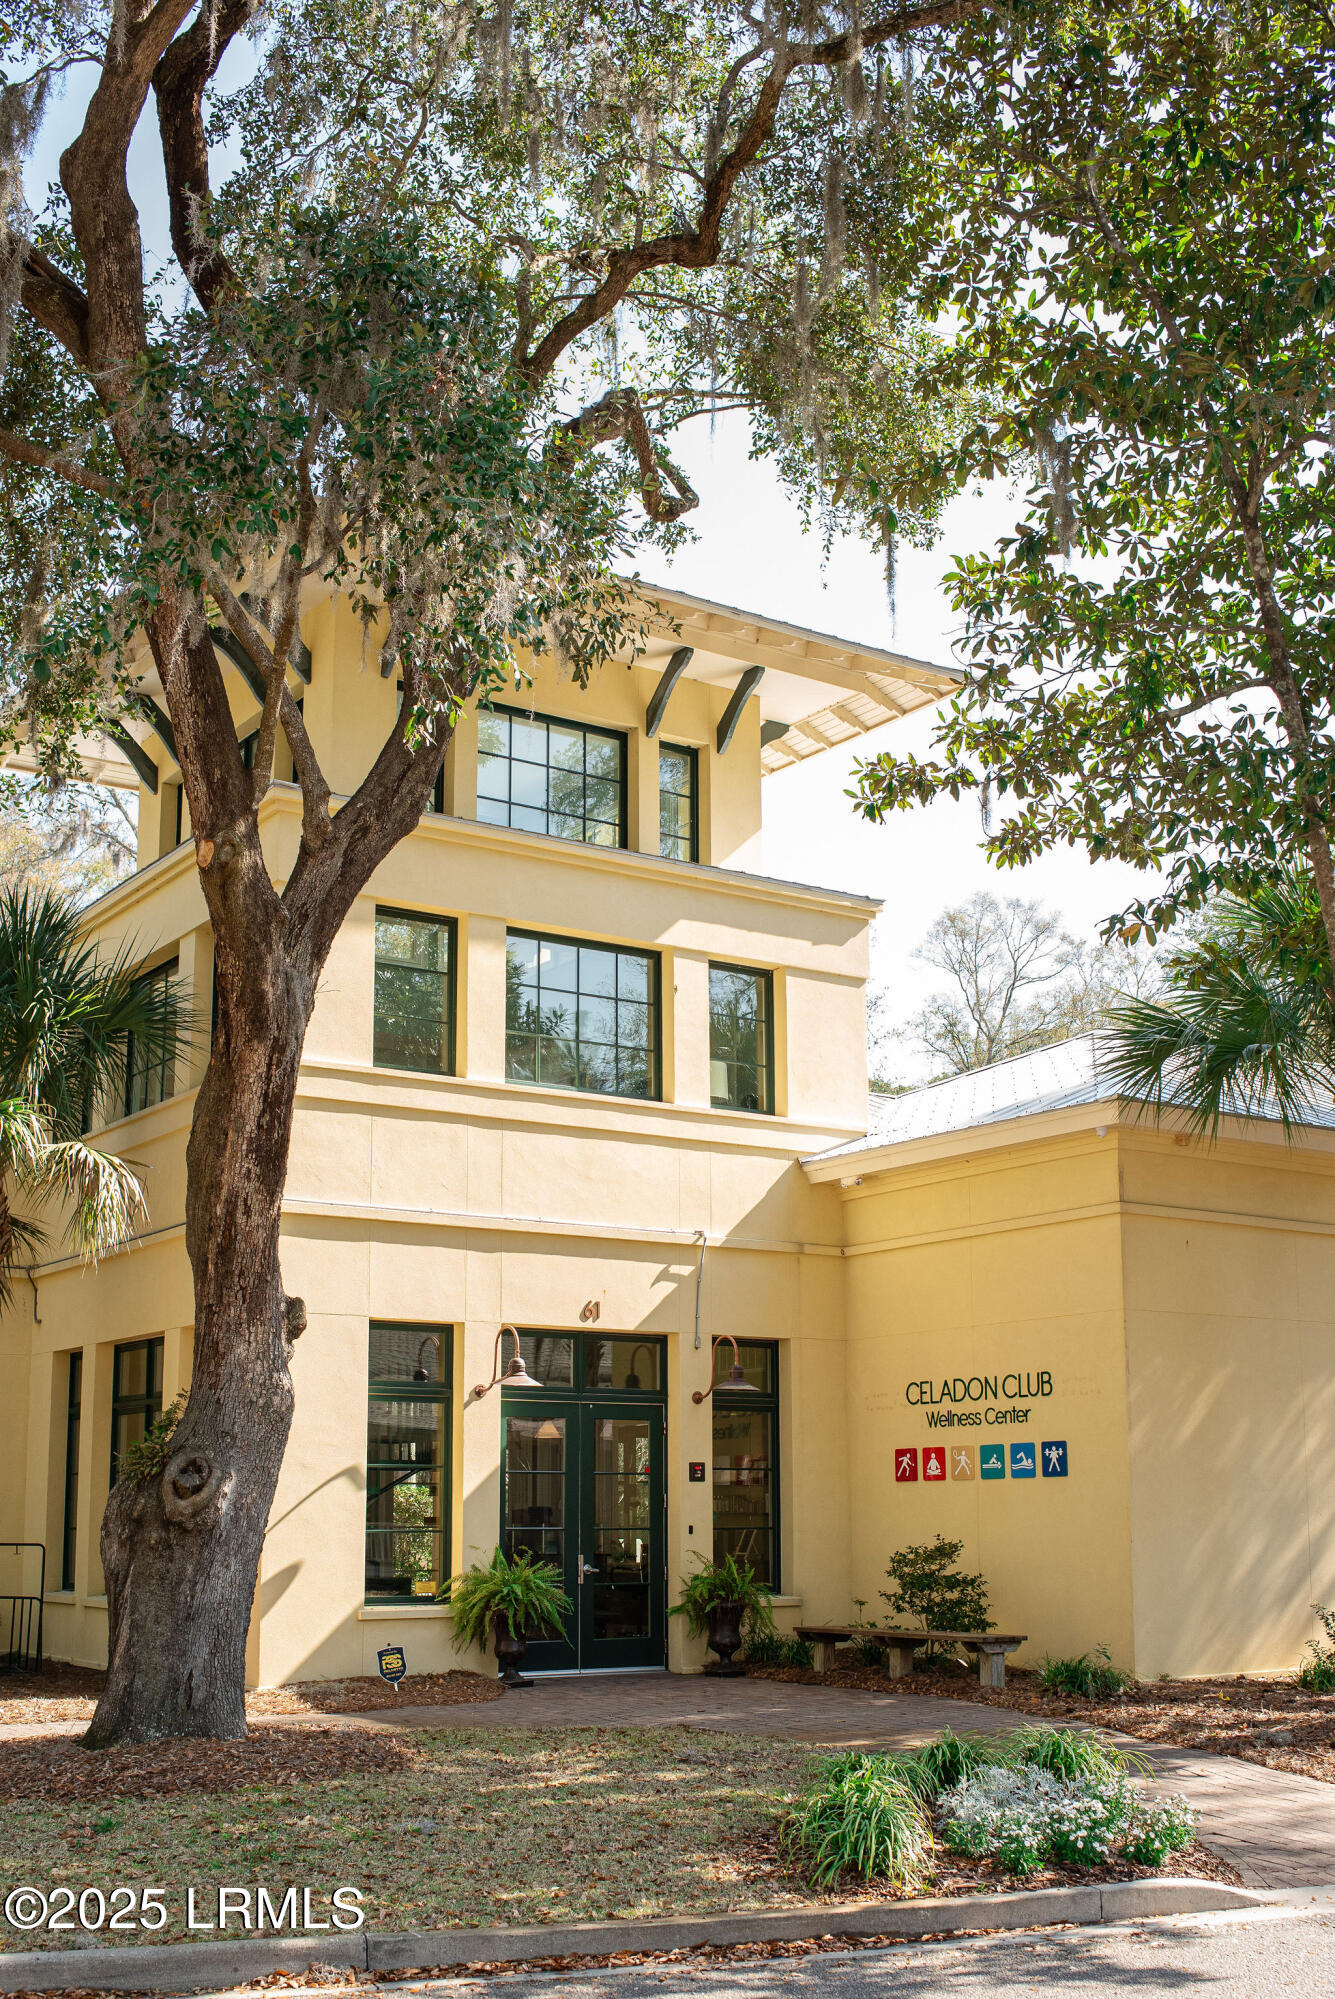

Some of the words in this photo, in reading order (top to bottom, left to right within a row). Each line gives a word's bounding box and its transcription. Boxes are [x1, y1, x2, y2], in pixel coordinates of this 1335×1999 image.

[584, 1300, 600, 1319] 61
[906, 1376, 998, 1405] CELADON
[1002, 1371, 1053, 1399] CLUB
[926, 1410, 982, 1428] Wellness
[985, 1406, 1031, 1425] Center
